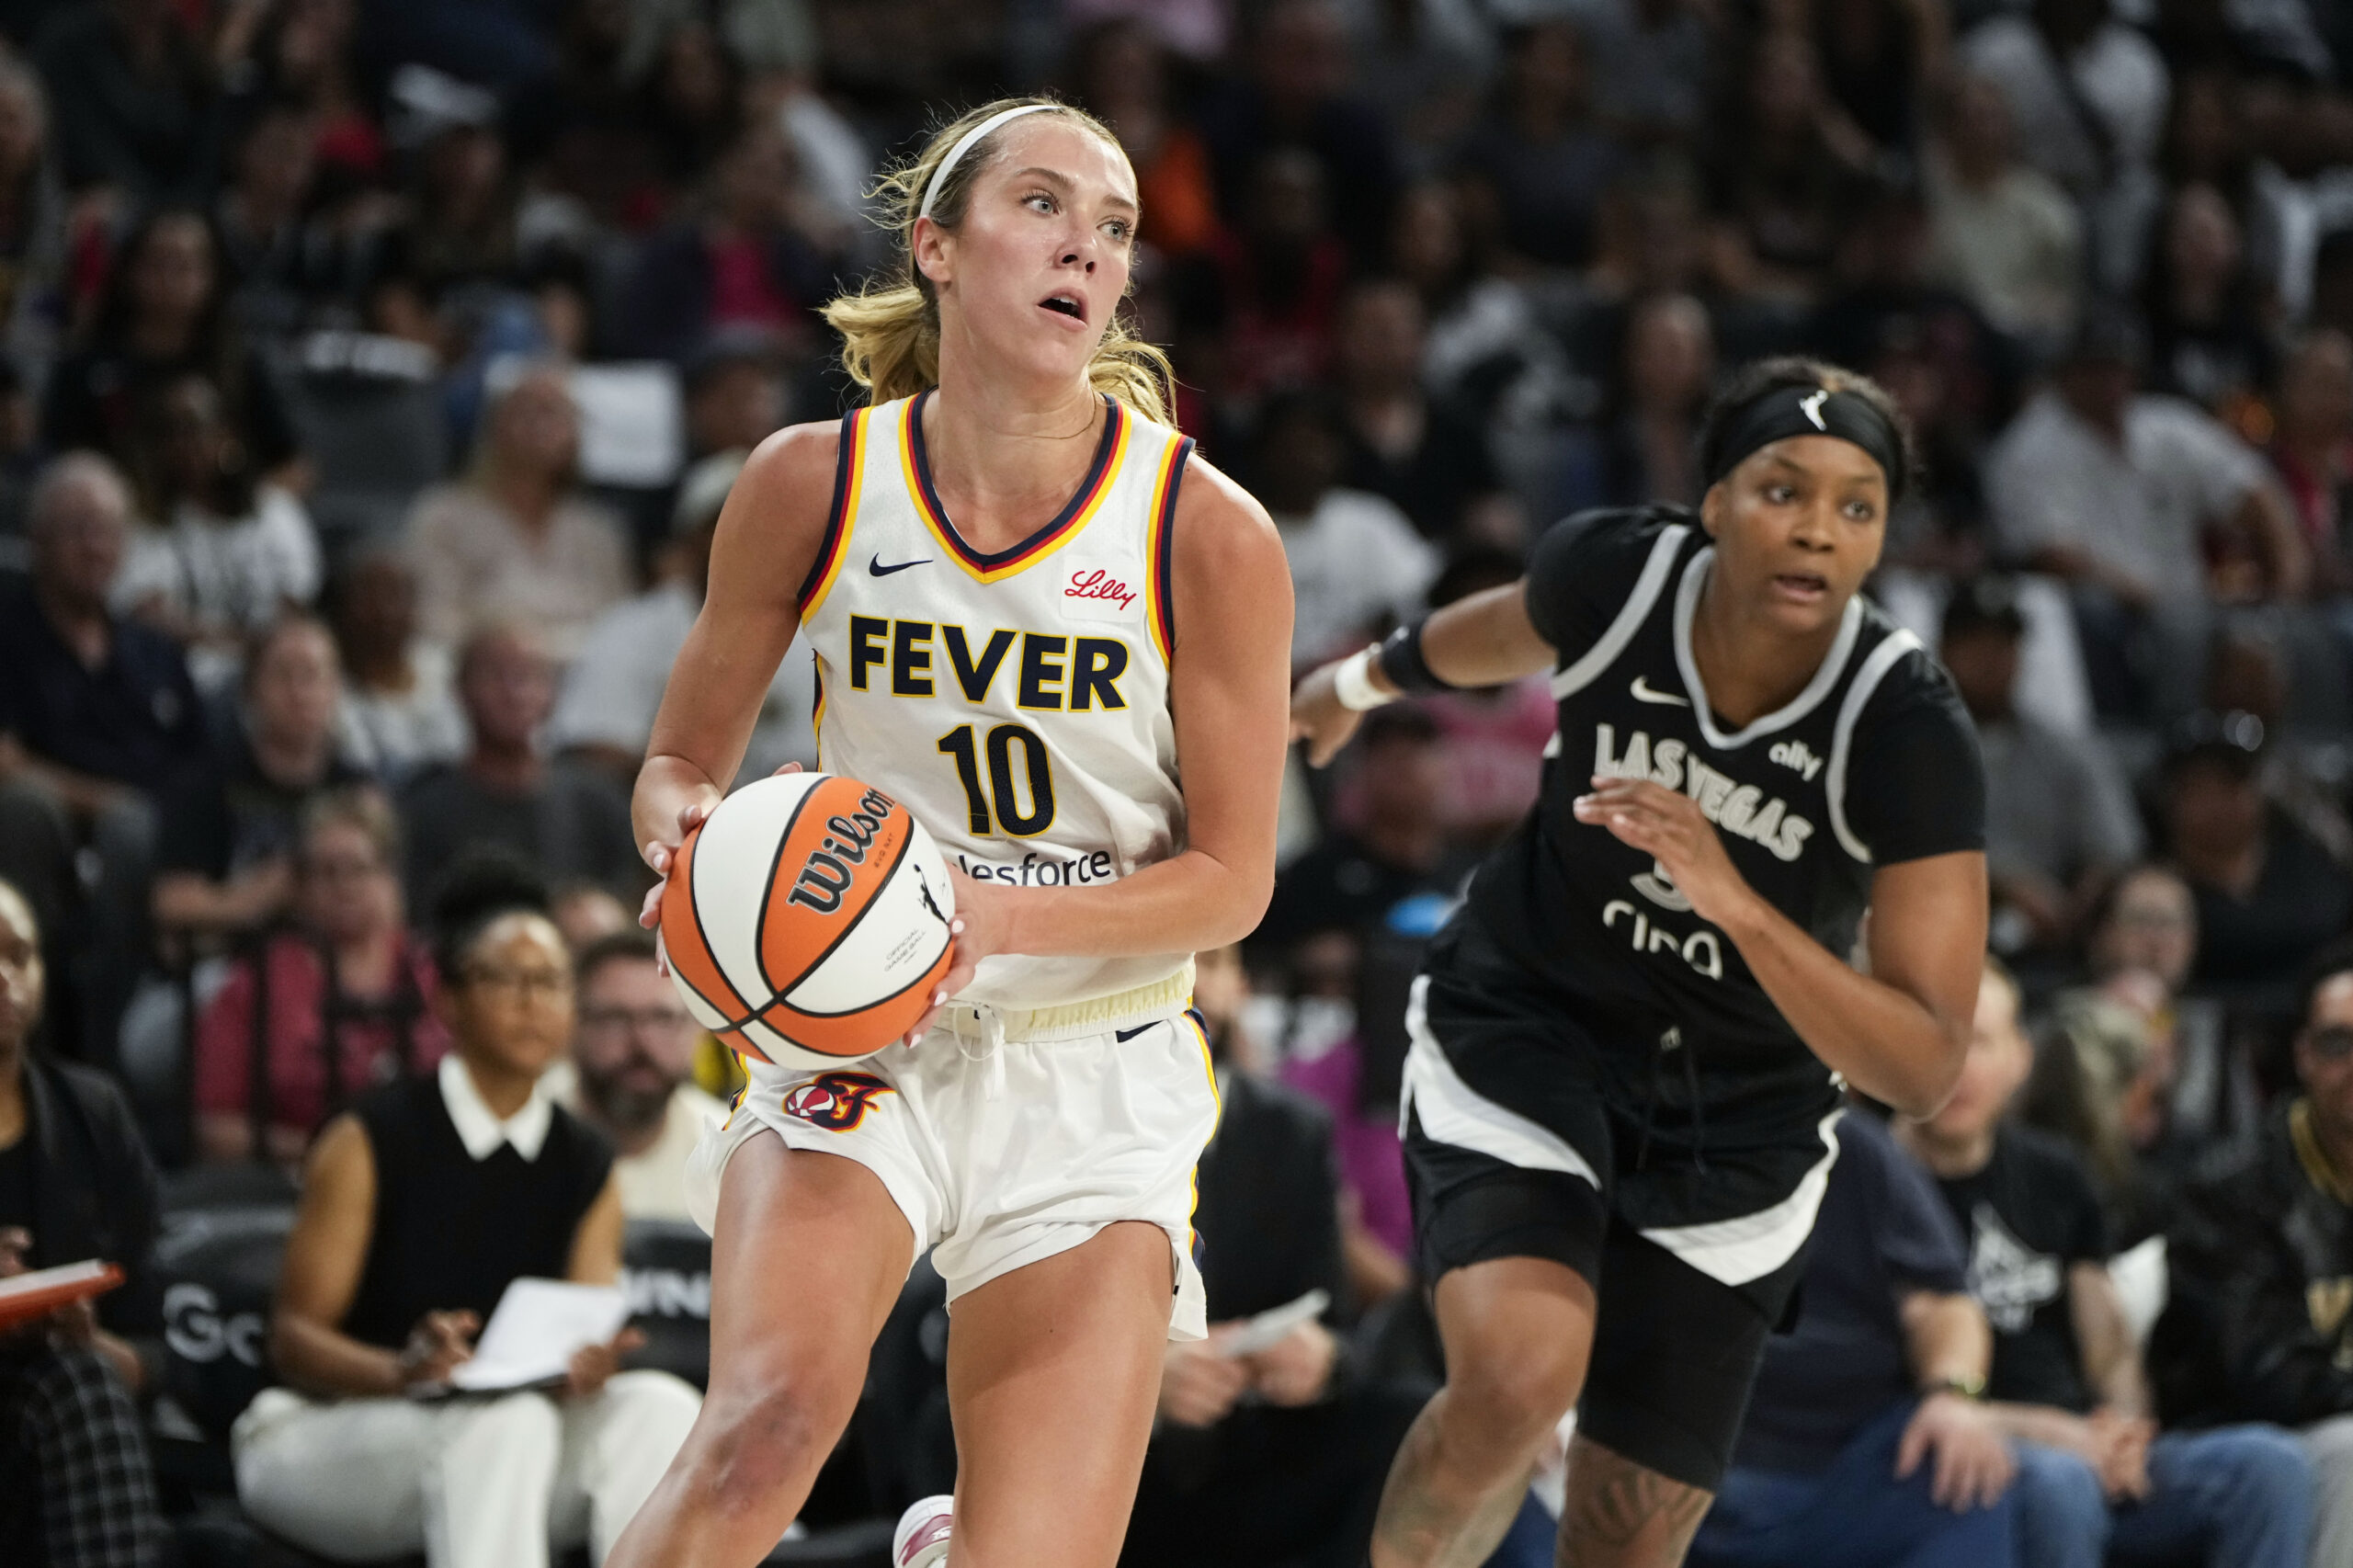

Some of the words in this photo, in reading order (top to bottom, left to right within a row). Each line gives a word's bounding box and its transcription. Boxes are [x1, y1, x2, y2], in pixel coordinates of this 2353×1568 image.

[1064, 569, 1137, 611] Lilly
[848, 612, 1131, 712] FEVER
[936, 722, 1056, 838] 10
[1593, 722, 1688, 790] LAS
[1686, 752, 1815, 862] VEGAS
[1768, 739, 1824, 781] ally
[786, 788, 897, 915] Wilson
[952, 849, 1111, 887] lesforce
